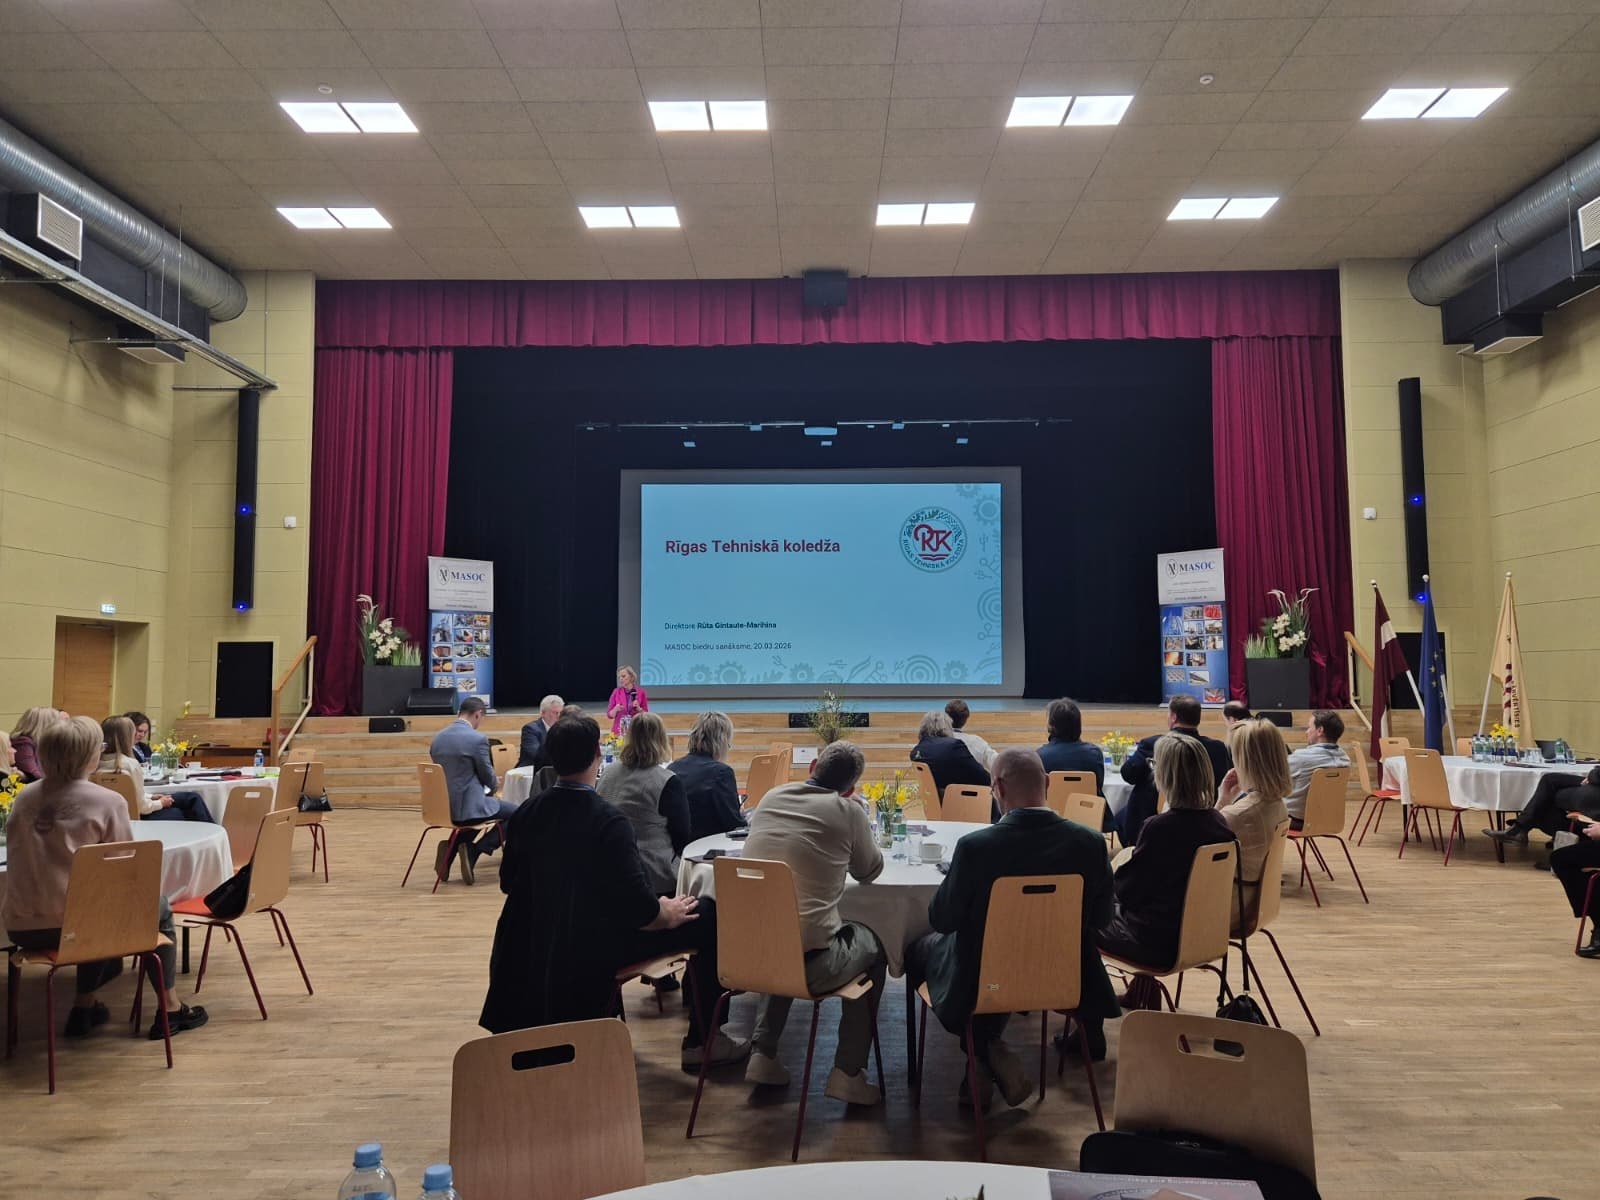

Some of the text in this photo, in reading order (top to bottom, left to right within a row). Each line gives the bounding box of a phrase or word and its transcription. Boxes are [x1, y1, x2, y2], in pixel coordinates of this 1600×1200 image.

[665, 539, 841, 556] Rīgas Tehniskā koledža
[1179, 561, 1216, 572] MASOC
[450, 571, 486, 581] MASOC
[664, 622, 696, 630] Direktore
[697, 621, 714, 629] Rūta
[664, 643, 691, 651] MASOC
